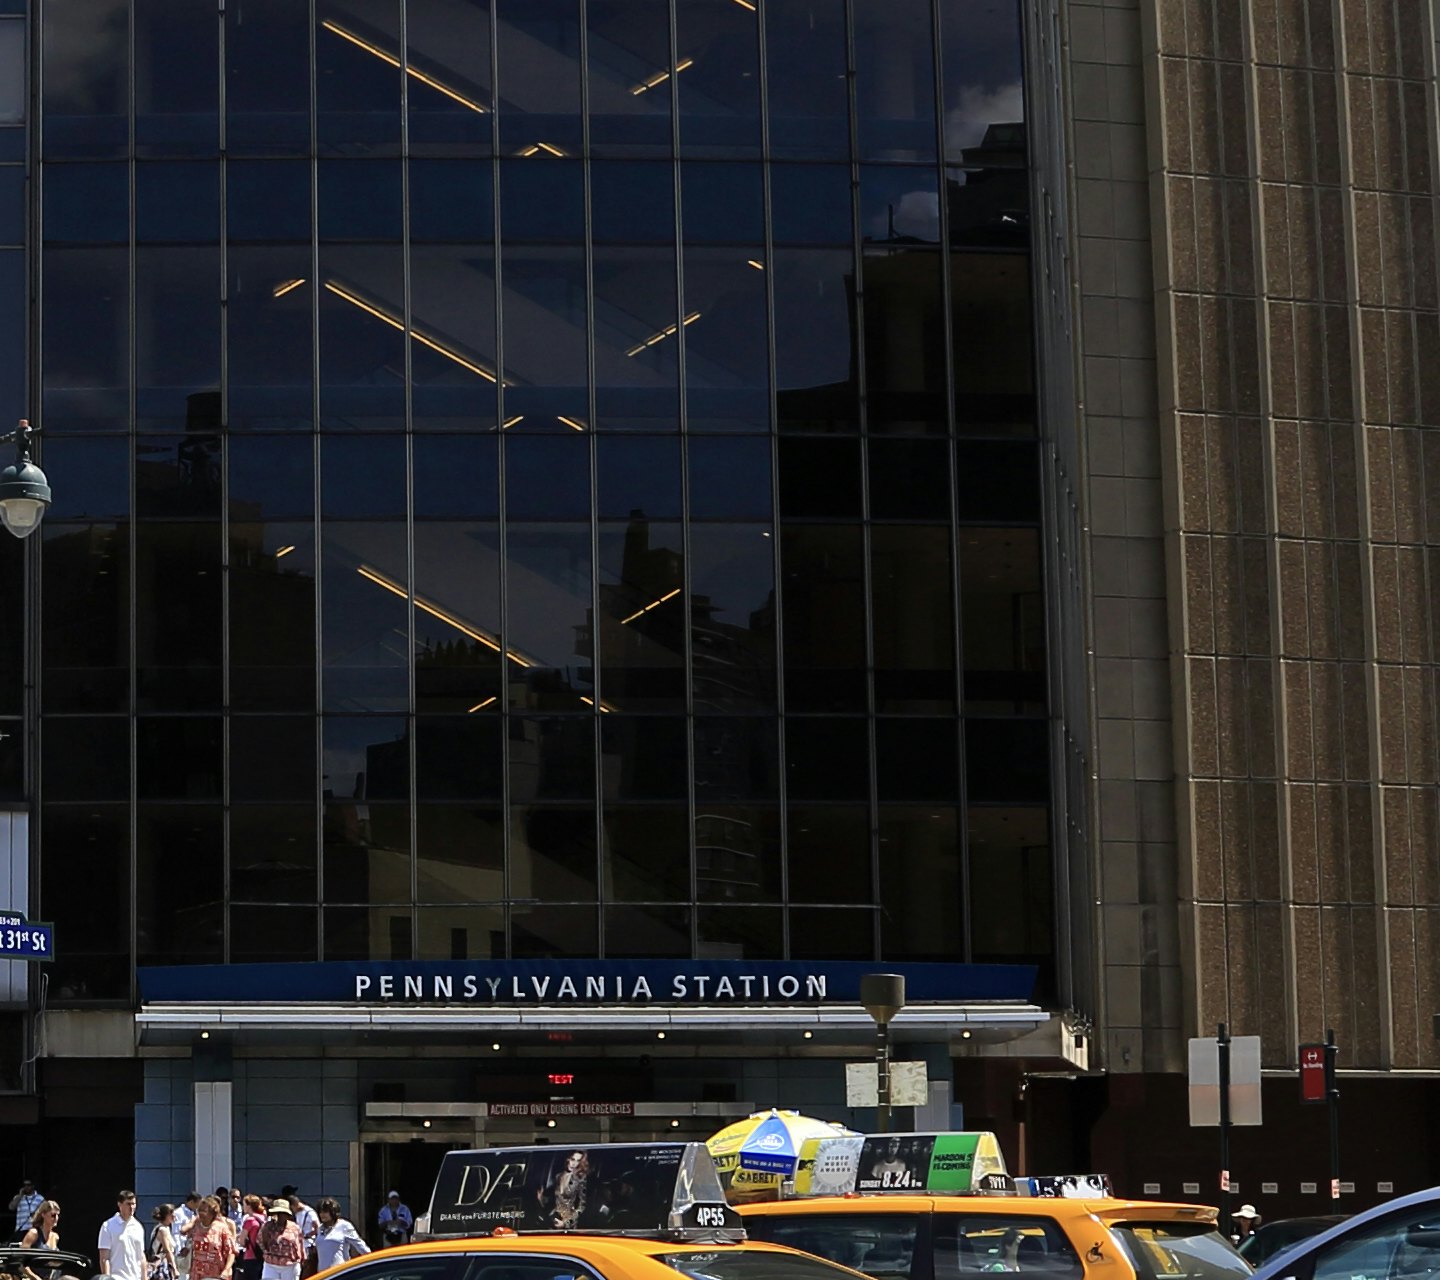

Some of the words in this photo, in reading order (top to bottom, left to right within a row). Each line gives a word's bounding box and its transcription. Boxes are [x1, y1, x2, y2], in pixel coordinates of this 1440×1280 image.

[6, 930, 30, 949] 31st
[32, 931, 46, 951] St
[356, 975, 652, 1000] PENNSYLVANIA
[672, 974, 827, 998] STATION
[490, 1104, 529, 1115] ACTIVATED
[530, 1104, 549, 1115] ONLY
[550, 1104, 578, 1115] DURING
[579, 1103, 632, 1115] EMERGENCIES
[882, 1170, 911, 1188] 8.24
[697, 1207, 724, 1226] 4P55
